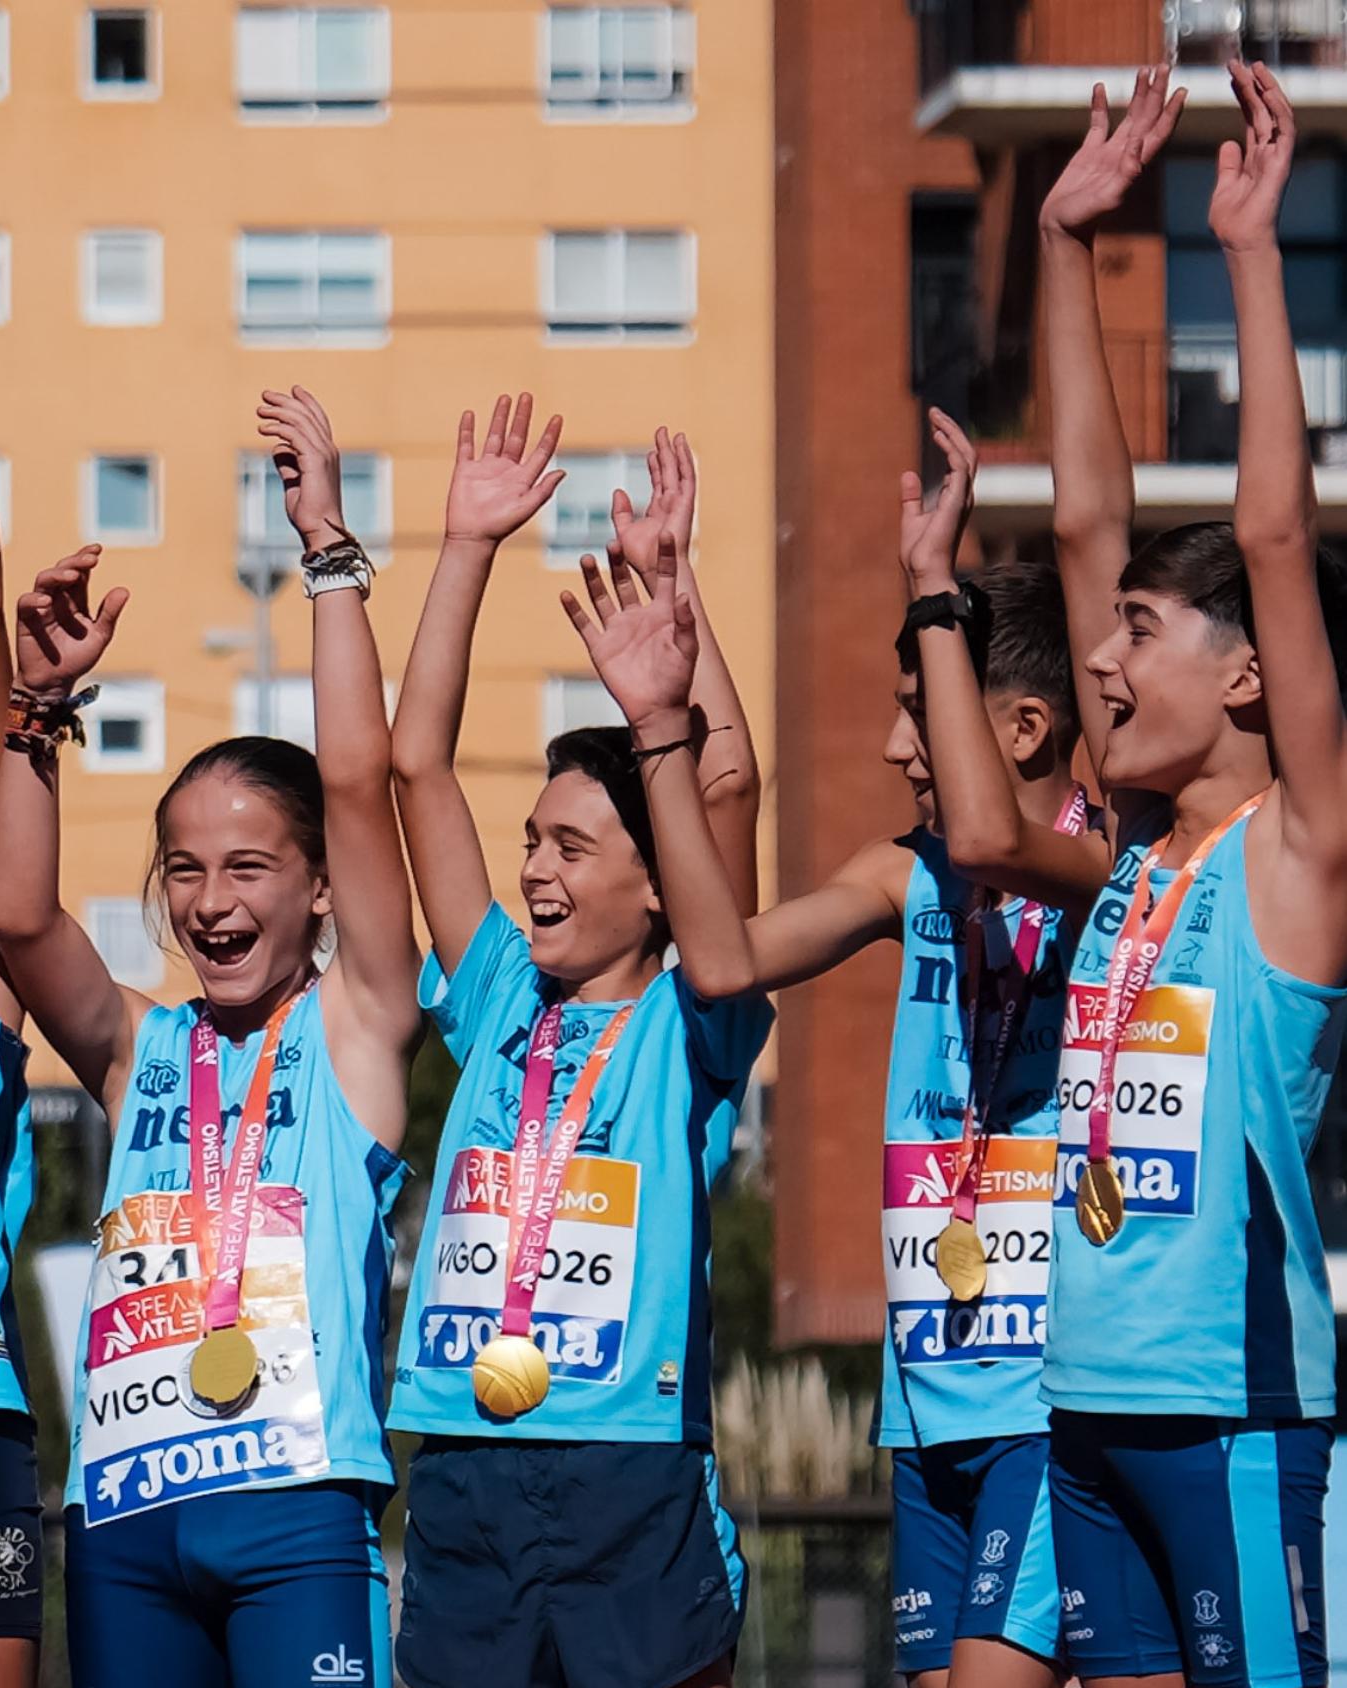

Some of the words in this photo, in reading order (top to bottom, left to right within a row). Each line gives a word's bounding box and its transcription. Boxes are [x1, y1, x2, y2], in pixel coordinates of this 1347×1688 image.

[1116, 1081, 1183, 1117] 026
[201, 1122, 223, 1211] ATLETISMO
[231, 1122, 263, 1218] ATLETISMO
[517, 1119, 541, 1218] ATLETISMO
[520, 1223, 547, 1268] RFEA
[534, 1120, 578, 1220] ATLETISMO
[438, 1242, 497, 1275] VIGO
[538, 1248, 613, 1286] 026
[127, 1292, 187, 1317] RFEA
[90, 1374, 180, 1427] VIGO
[312, 1644, 365, 1676] als
